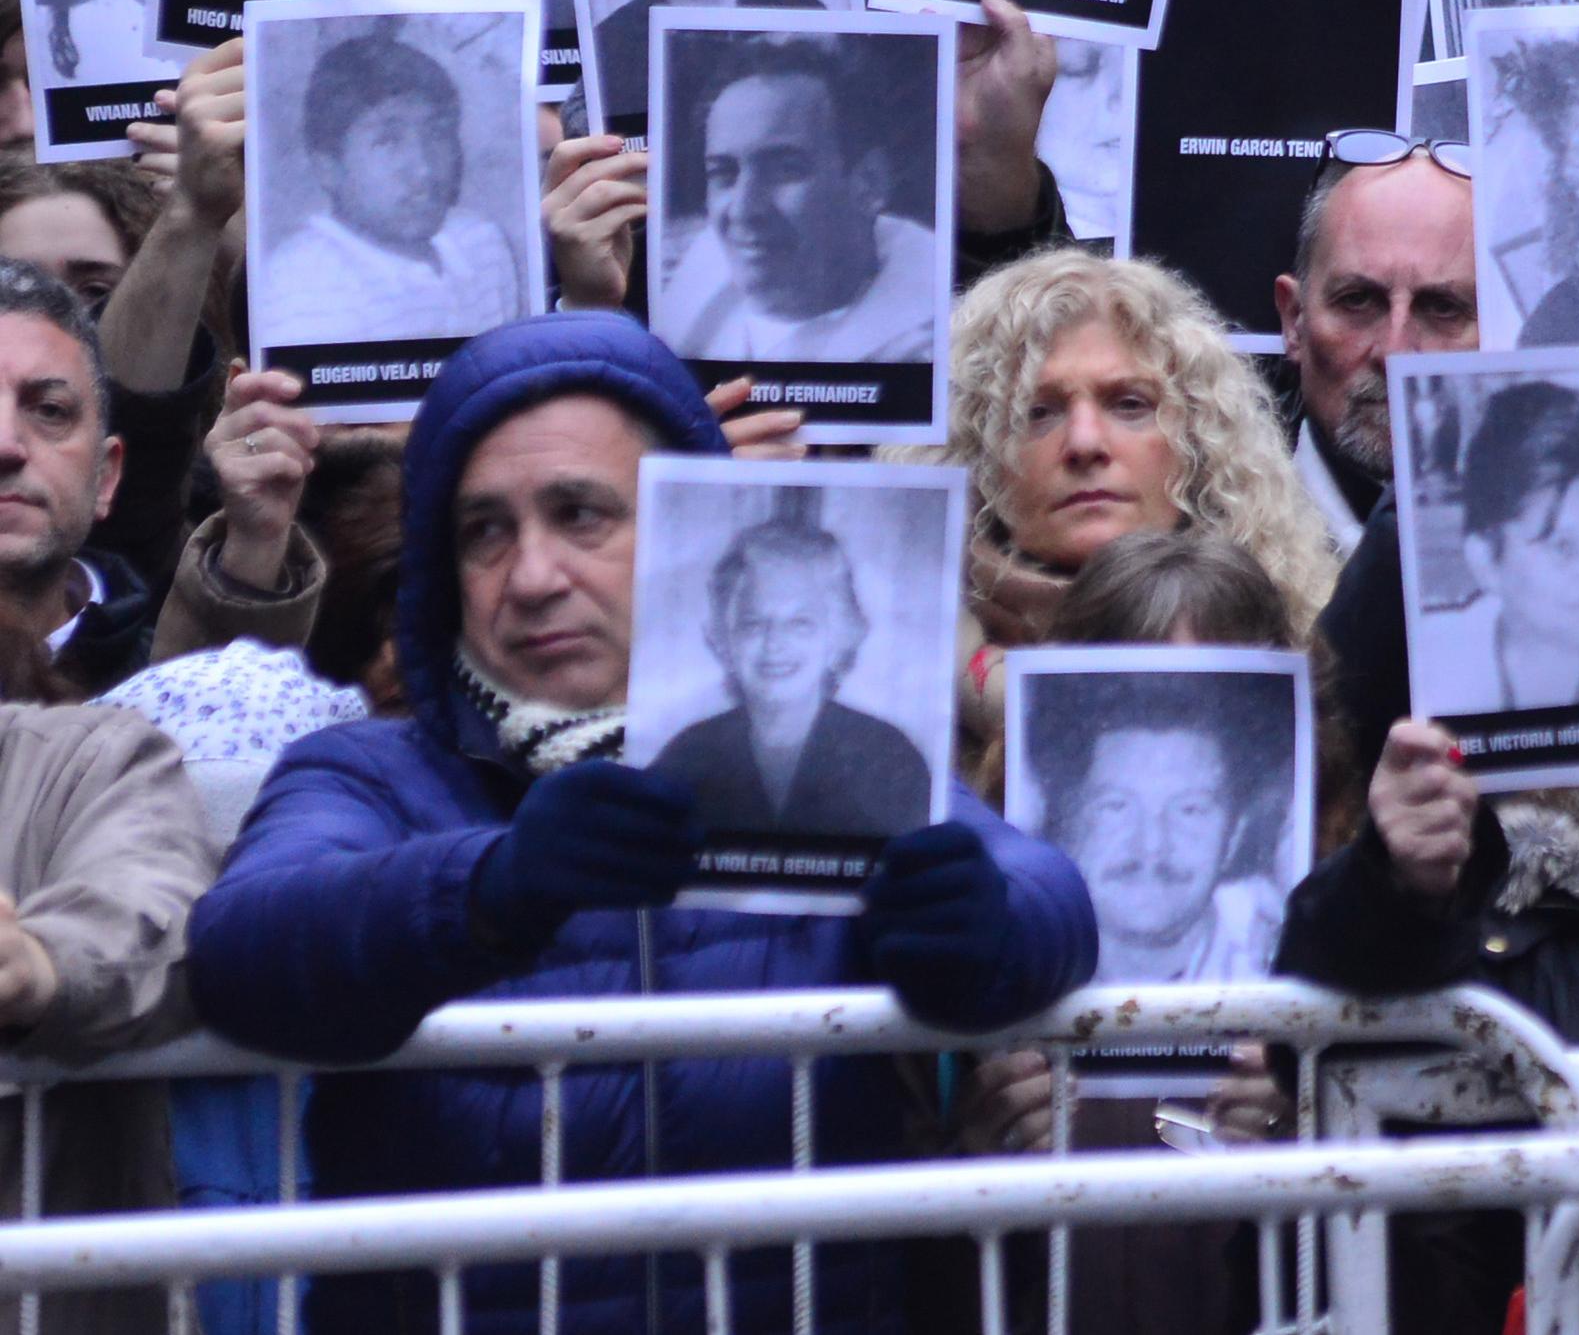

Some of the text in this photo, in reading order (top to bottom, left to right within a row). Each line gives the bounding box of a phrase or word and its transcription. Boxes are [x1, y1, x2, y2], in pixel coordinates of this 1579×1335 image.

[187, 8, 227, 29] HUGO
[541, 49, 581, 66] SILVIA
[85, 104, 142, 123] VIVIANA
[1180, 137, 1226, 155] ERWIN
[1230, 138, 1284, 156] GARCIA
[311, 365, 376, 385] EUGENIO
[380, 363, 419, 382] VELA
[784, 385, 878, 404] FERNANDEZ
[1456, 737, 1486, 756] BEL
[1489, 731, 1554, 754] VICTORIA
[714, 855, 779, 876] VIOLETA
[783, 857, 839, 877] BEHAR
